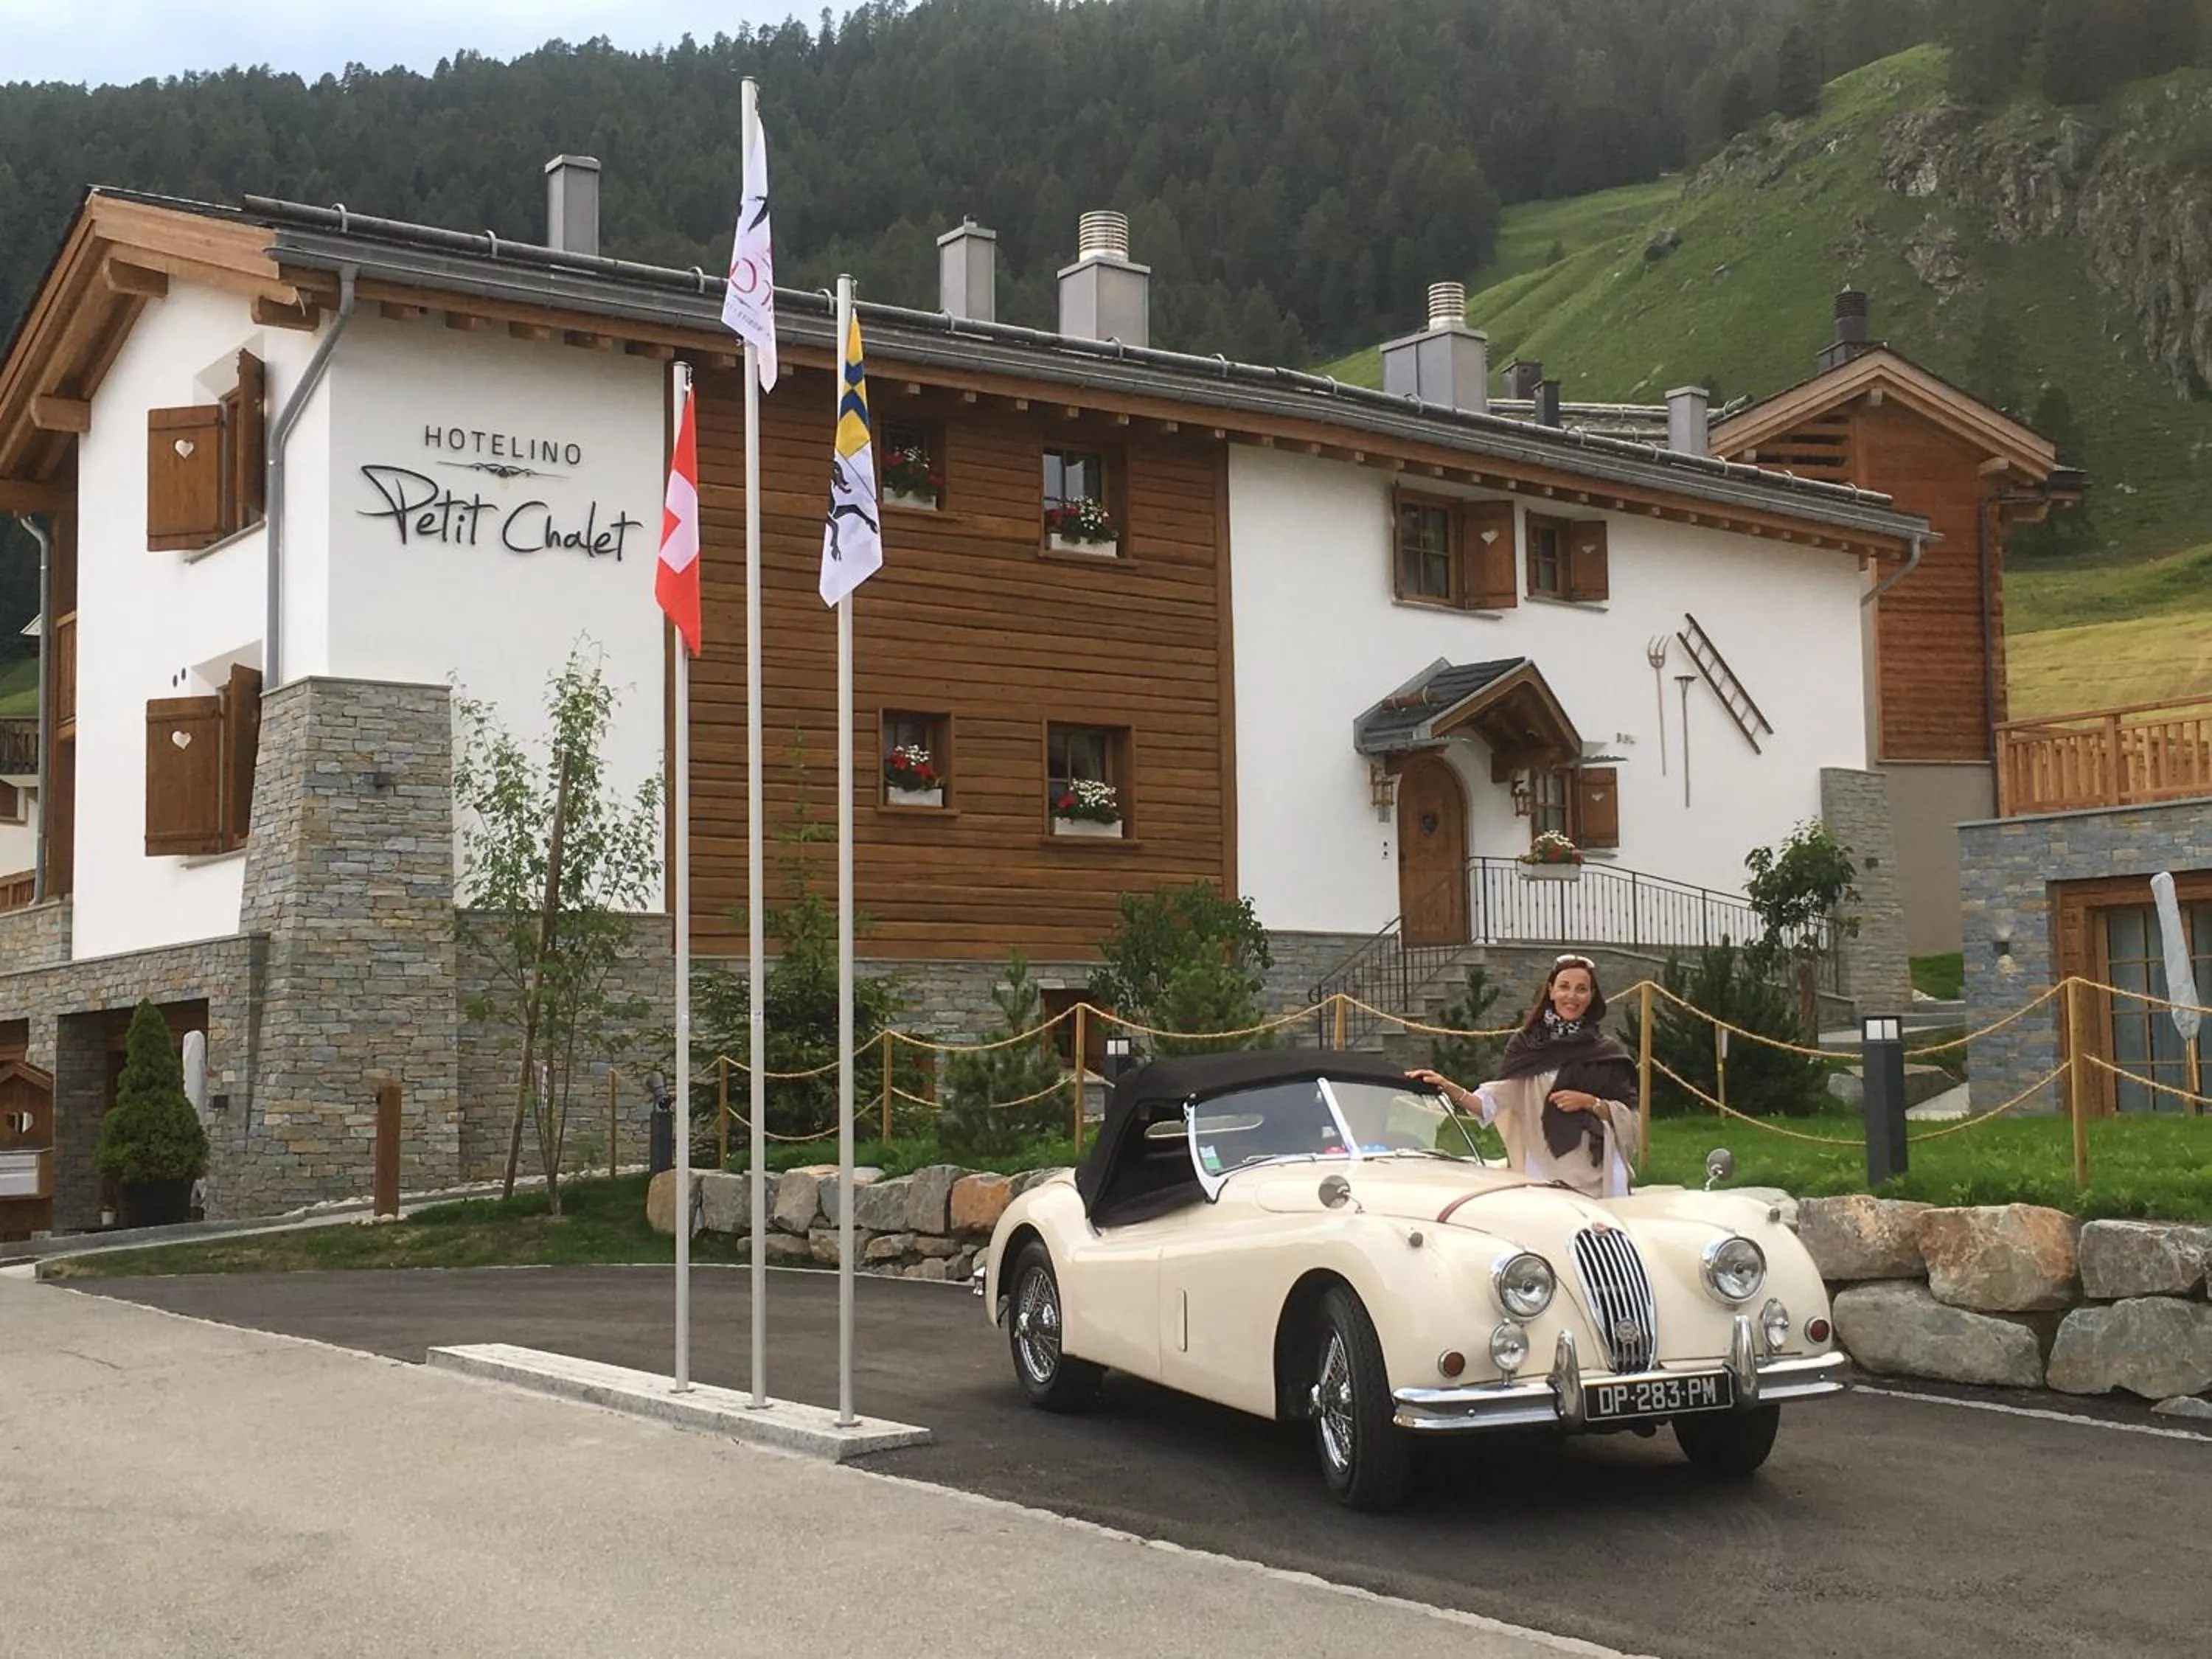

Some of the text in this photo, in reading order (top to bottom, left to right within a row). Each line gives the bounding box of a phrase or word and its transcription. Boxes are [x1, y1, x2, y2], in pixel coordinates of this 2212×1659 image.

[424, 425, 581, 465] HOTELINO
[356, 465, 644, 562] Petit Chalet
